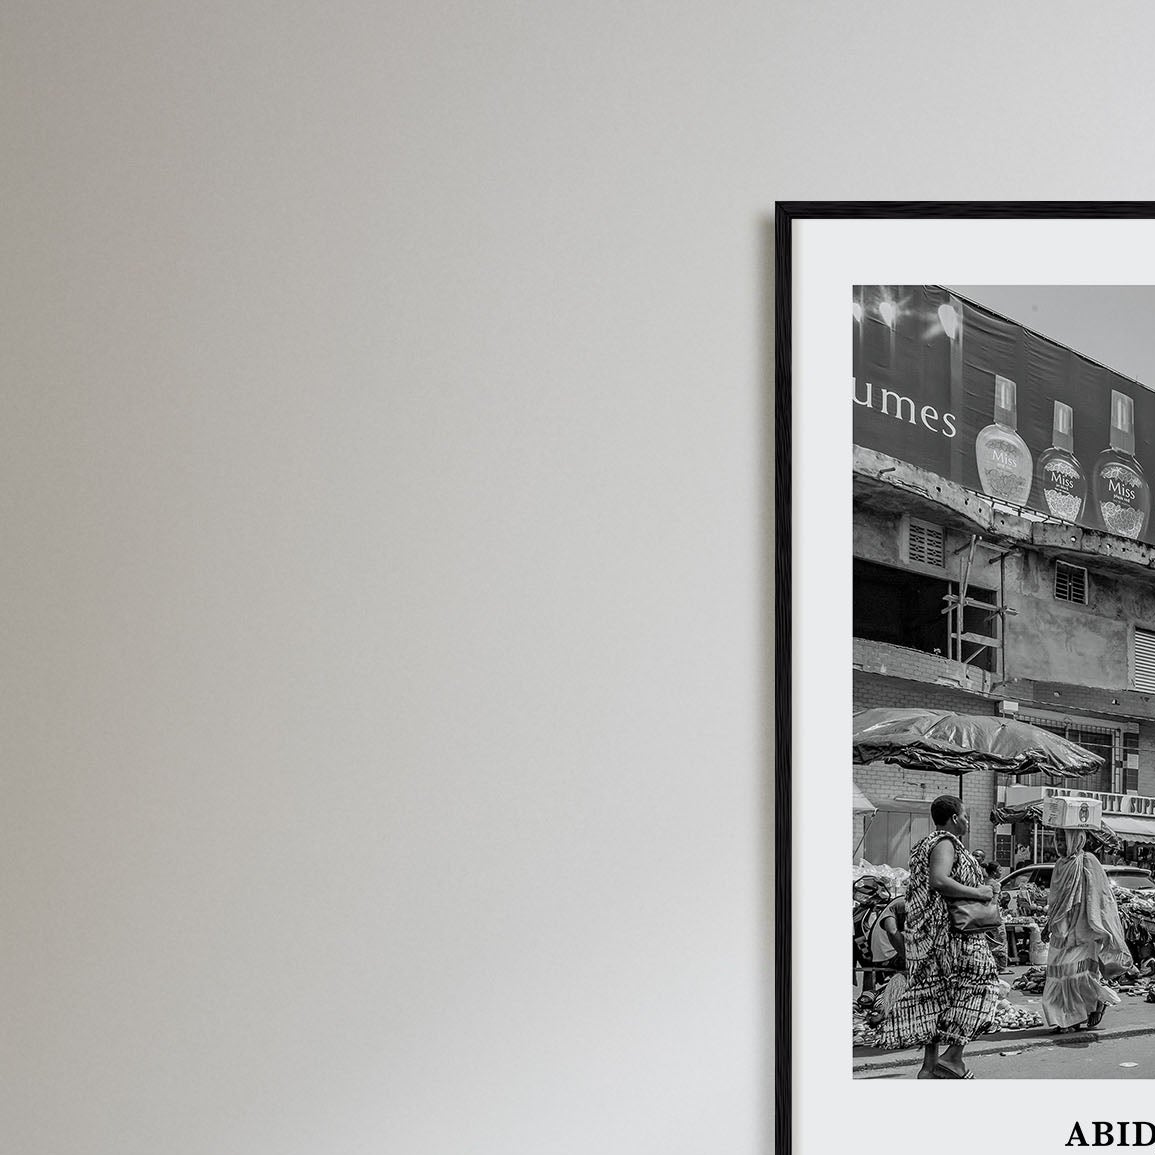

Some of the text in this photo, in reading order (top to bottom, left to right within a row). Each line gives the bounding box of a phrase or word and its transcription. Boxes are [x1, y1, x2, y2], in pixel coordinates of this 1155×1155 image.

[852, 377, 956, 438] umes
[992, 450, 1017, 468] Miss
[1051, 472, 1074, 489] Miss
[1108, 479, 1136, 500] Miss
